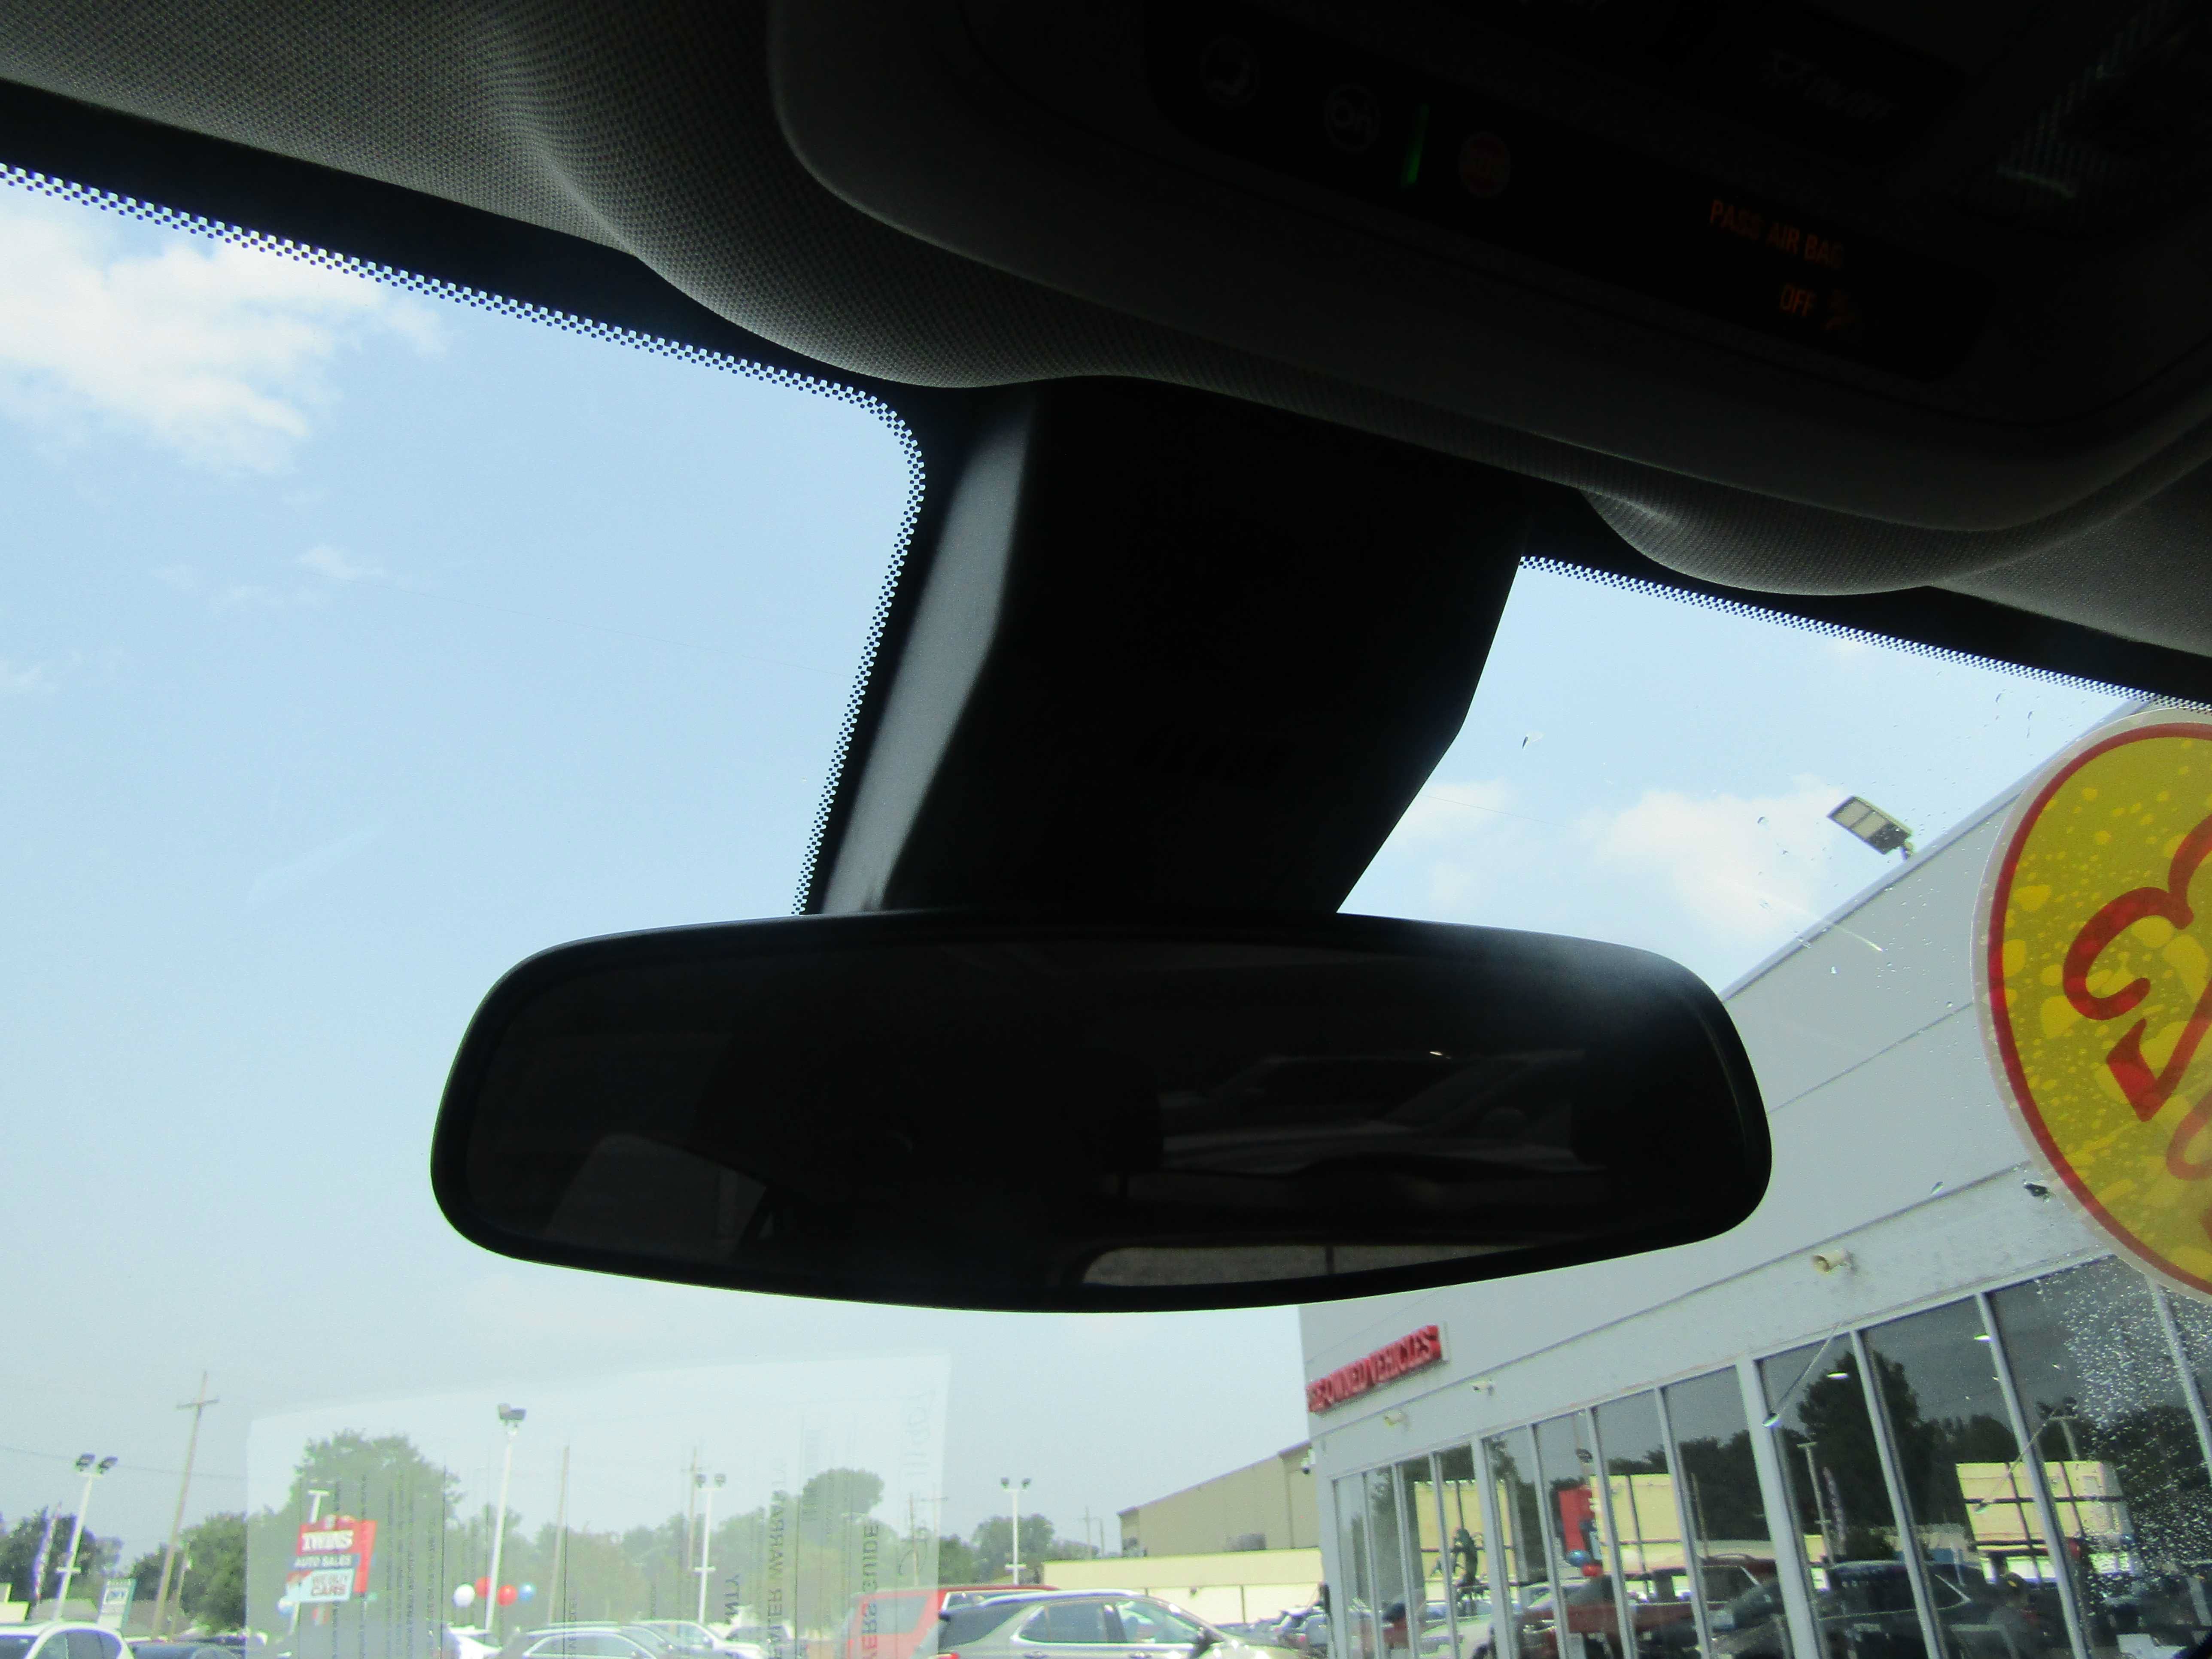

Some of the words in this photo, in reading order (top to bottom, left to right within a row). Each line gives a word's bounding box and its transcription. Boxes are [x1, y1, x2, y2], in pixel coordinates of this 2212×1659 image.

[1709, 198, 1765, 241] PASS
[1765, 220, 1801, 255] AIR
[1803, 233, 1844, 269] BAG
[1779, 283, 1817, 317] OFF
